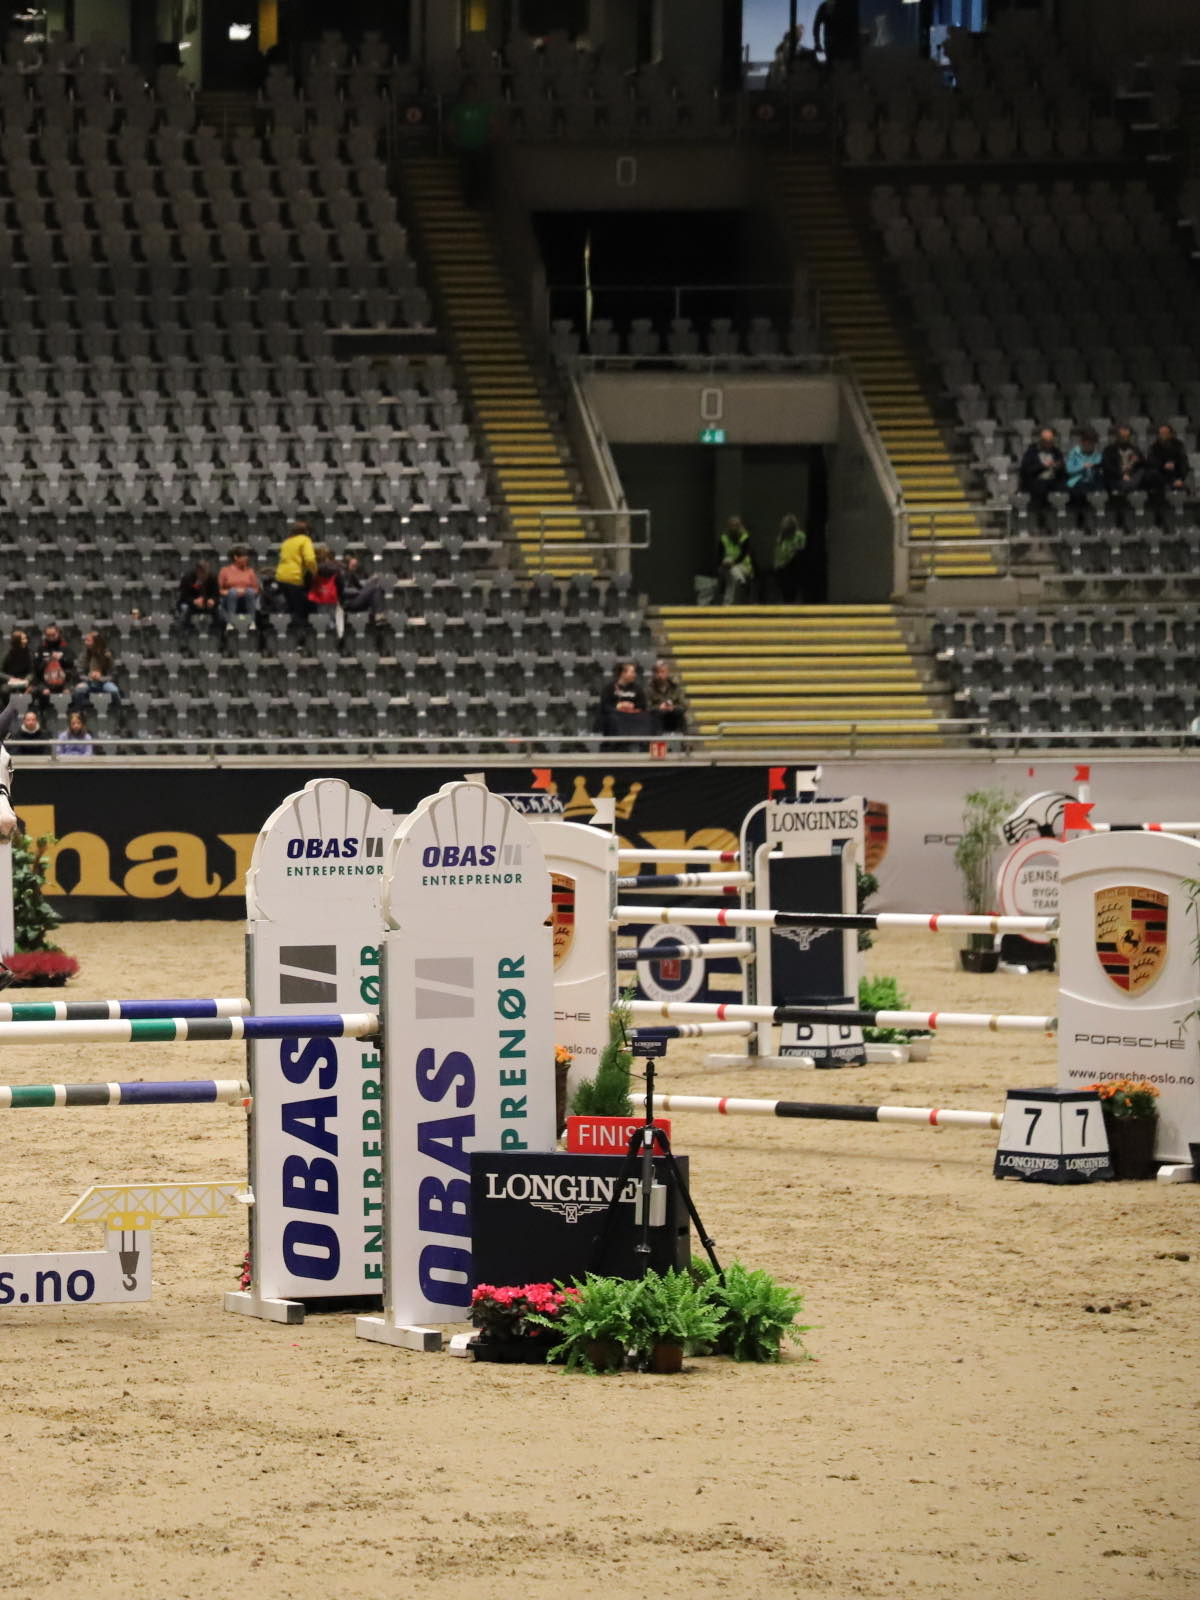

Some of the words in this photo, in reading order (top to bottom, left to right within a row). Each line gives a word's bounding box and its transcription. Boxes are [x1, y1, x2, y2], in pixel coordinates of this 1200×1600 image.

[771, 809, 859, 832] LONGINES
[287, 837, 359, 859] OBAS
[422, 845, 497, 867] OBAS
[287, 865, 384, 876] ENTREPRENØR
[422, 874, 523, 886] ENTREPRENØR
[1021, 870, 1060, 885] JENSE
[1031, 888, 1059, 898] BYGG
[1033, 900, 1059, 909] TEAM
[497, 955, 528, 1150] PRENØR
[1075, 1034, 1185, 1049] PORSCHE
[1069, 1068, 1195, 1085] www.porsche-oslo.no
[360, 945, 382, 1280] ENTREPREØR
[1024, 1107, 1042, 1146] 7
[1076, 1109, 1089, 1147] 7
[280, 1036, 340, 1281] OBAS
[999, 1155, 1059, 1170] LONGINES
[1065, 1156, 1110, 1169] LONGINES
[415, 1047, 477, 1307] OBAS
[486, 1173, 637, 1203] LONGINE
